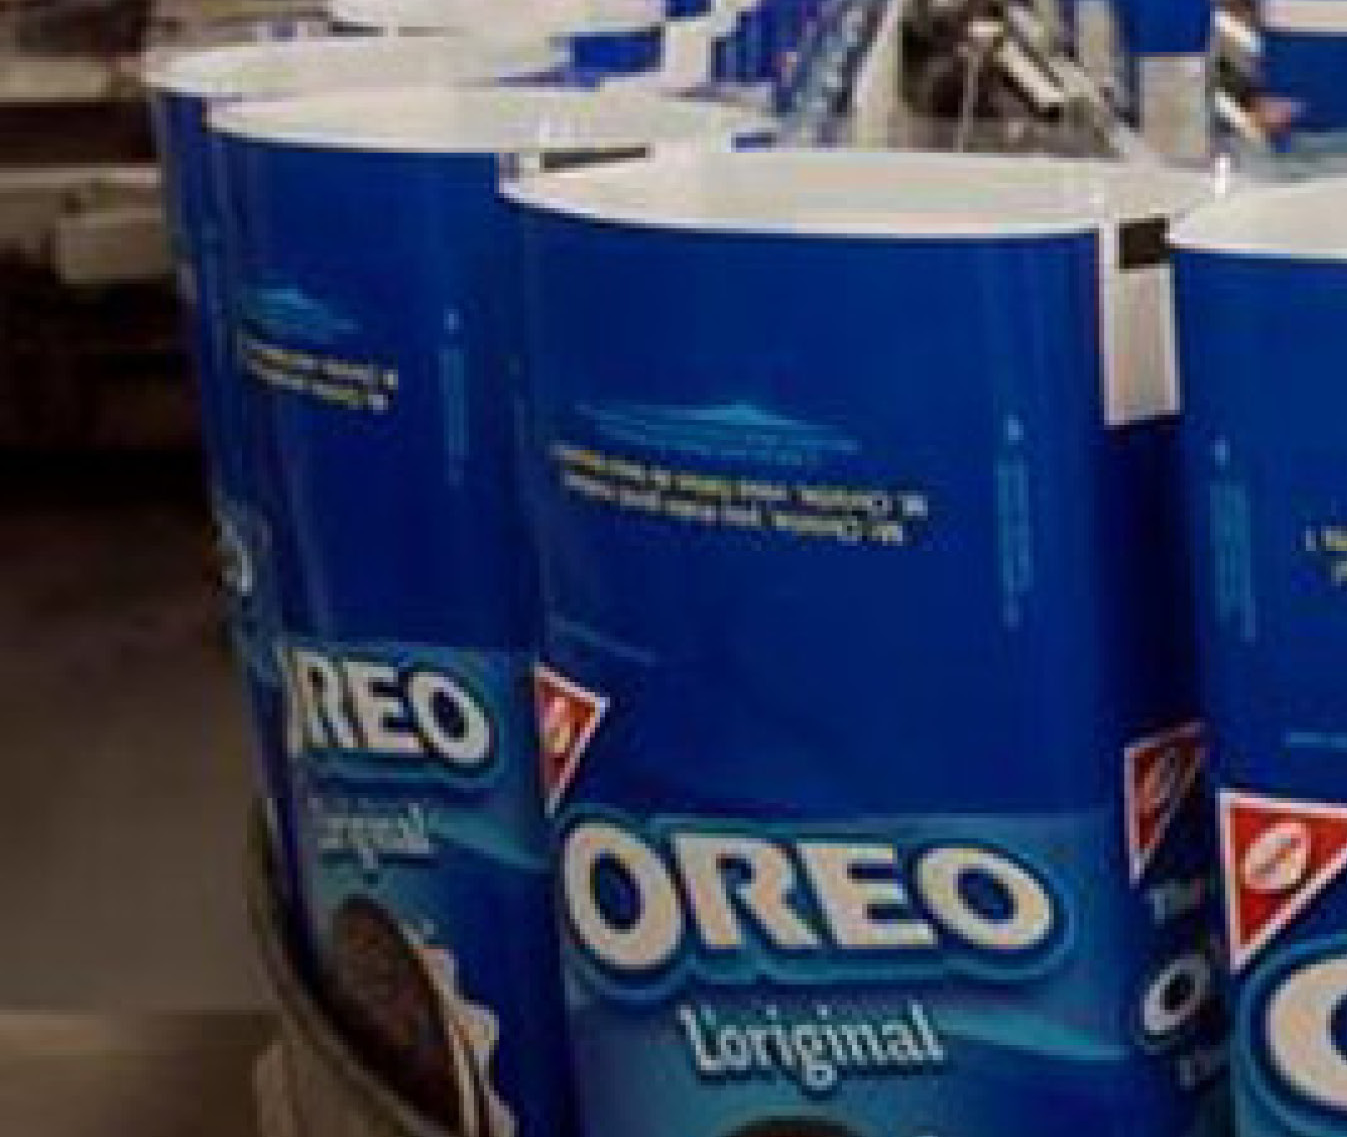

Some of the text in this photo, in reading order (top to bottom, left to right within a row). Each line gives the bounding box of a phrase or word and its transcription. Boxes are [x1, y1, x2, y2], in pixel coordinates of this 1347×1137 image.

[288, 646, 491, 765] REO
[564, 822, 1053, 969] OREO
[680, 1004, 946, 1093] L'original
